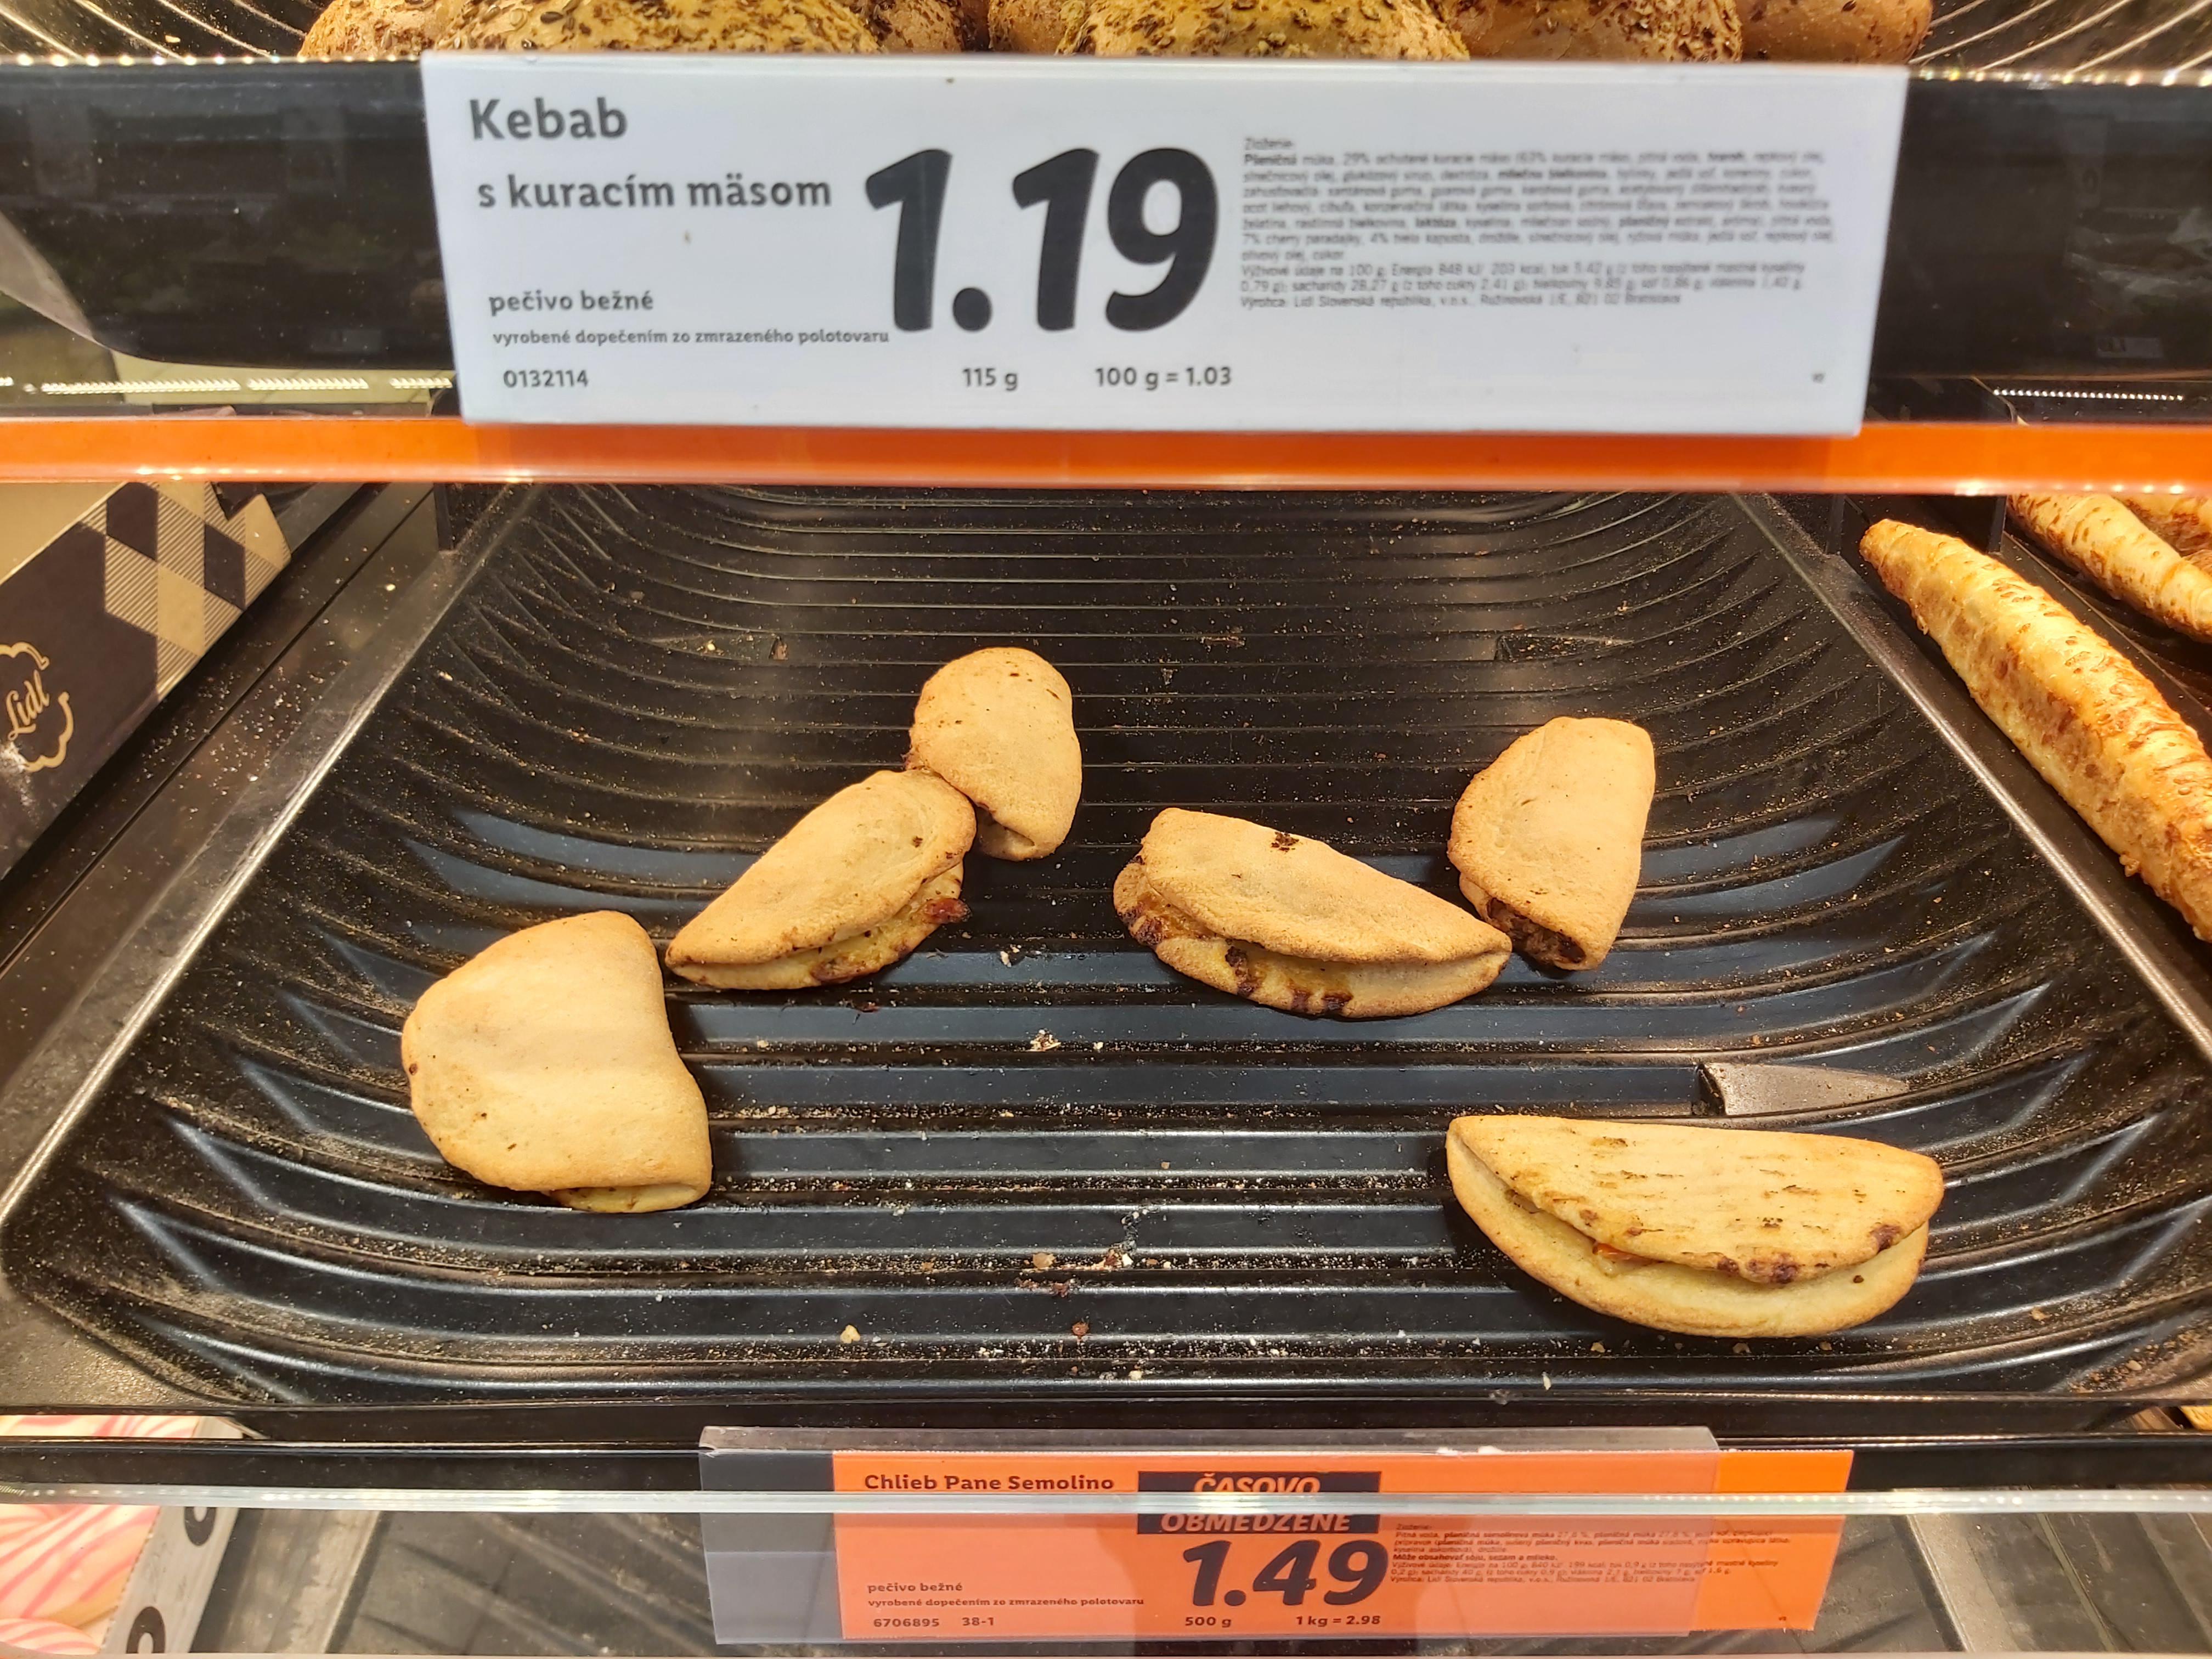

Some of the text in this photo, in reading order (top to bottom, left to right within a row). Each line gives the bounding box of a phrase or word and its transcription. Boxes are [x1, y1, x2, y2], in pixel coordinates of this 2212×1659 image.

[469, 96, 628, 140] Kebab
[477, 172, 832, 209] s kuracím mäsom
[864, 146, 1220, 333] 1.19
[488, 289, 654, 318] pečivo bežné
[492, 328, 890, 348] vyrobené dopečením zo zmrazeného polotovaru
[503, 369, 590, 388] 0132114
[962, 367, 1018, 392] 115 g
[1094, 366, 1232, 391] 100 g = 1.03
[7, 669, 50, 741] Lidl
[864, 1474, 1115, 1491] Chlieb Pane Semolino
[1182, 1539, 1389, 1607] 1.49
[867, 1582, 963, 1594] pečivo bežné
[867, 1598, 923, 1609] vyrobené
[925, 1598, 991, 1608] dopečením
[1008, 1597, 1079, 1606] zmrazeného
[1080, 1597, 1145, 1607] polotovaru
[872, 1616, 995, 1628] 6706895 38-1
[1184, 1616, 1232, 1628] 500 g
[1296, 1615, 1304, 1626] 1
[1307, 1615, 1328, 1627] kg
[1345, 1615, 1381, 1626] 2.98
